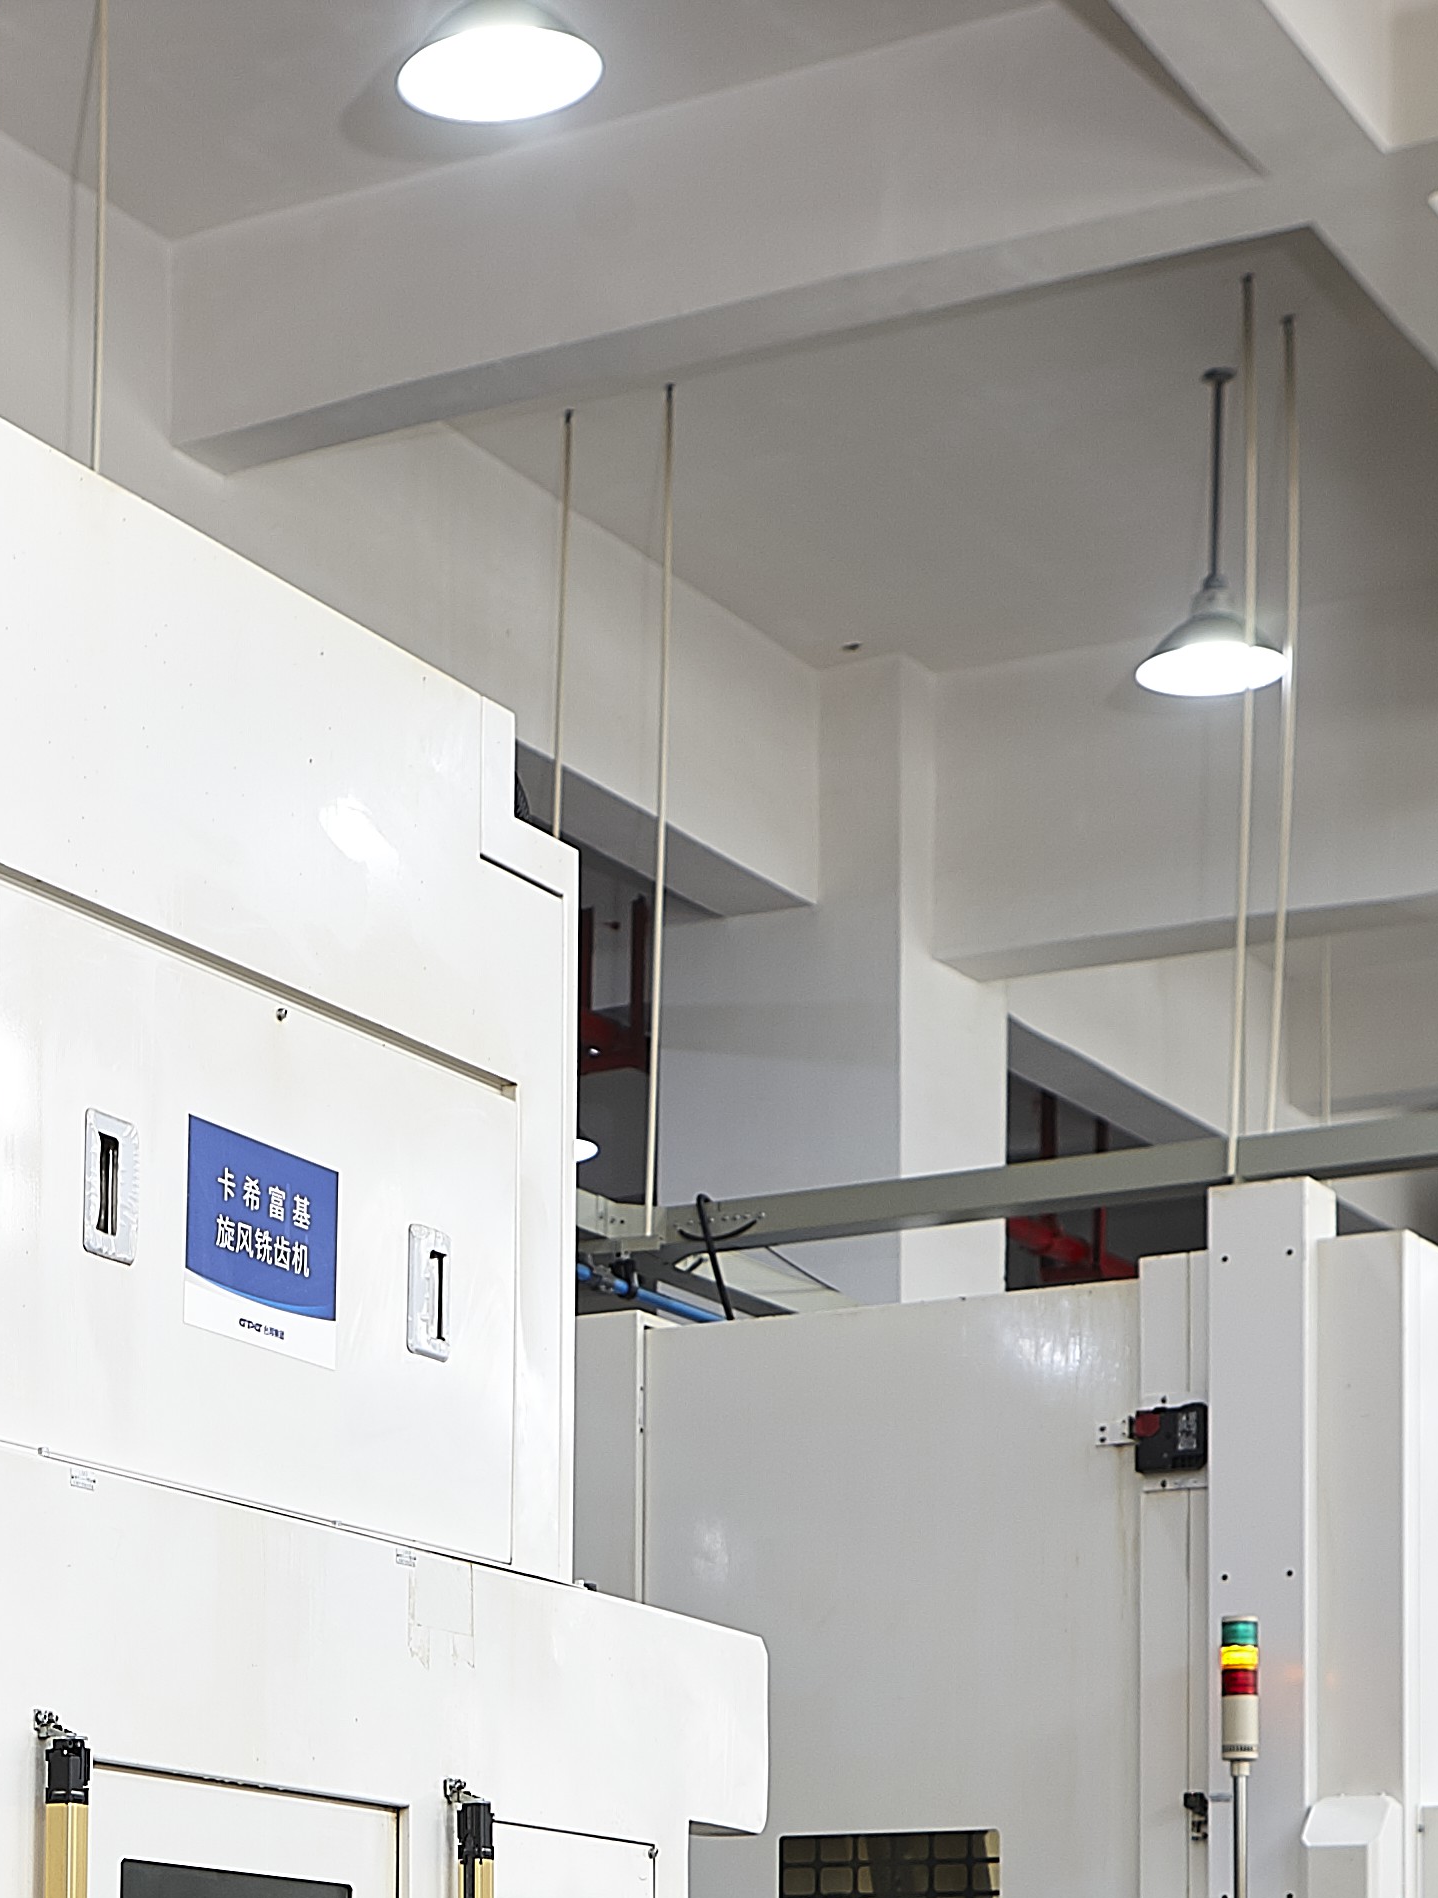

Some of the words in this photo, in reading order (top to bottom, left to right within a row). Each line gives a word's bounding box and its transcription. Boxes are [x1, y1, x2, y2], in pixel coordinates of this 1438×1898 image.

[217, 1167, 311, 1230] 卡希富基
[216, 1213, 310, 1278] 旋风铣齿机
